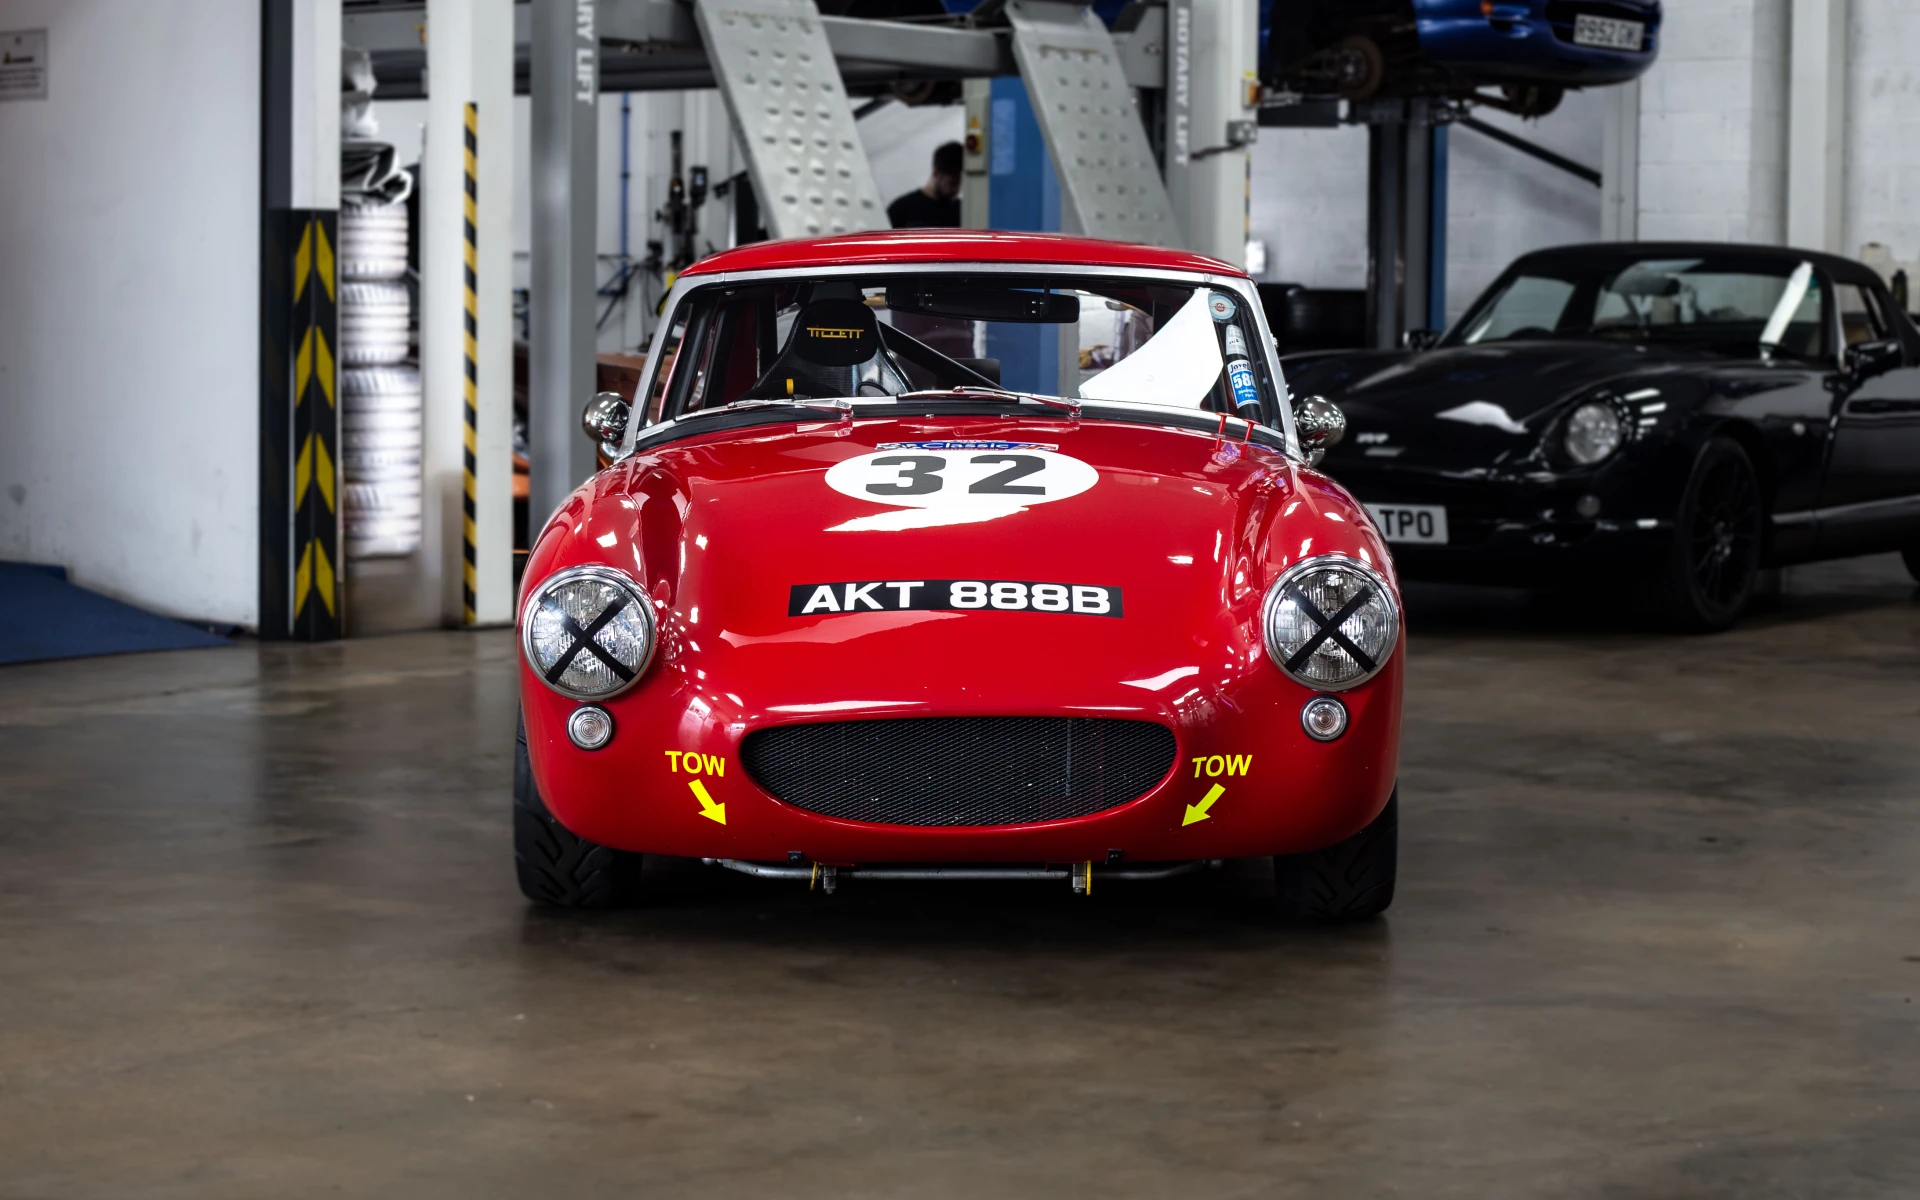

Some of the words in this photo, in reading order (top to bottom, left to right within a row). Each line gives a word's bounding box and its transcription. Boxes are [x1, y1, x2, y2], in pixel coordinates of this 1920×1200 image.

[577, 0, 593, 41] RY
[1176, 7, 1189, 107] ROTARY
[576, 49, 593, 106] LIFT
[1176, 115, 1188, 167] LIFT
[807, 327, 864, 339] TILLETT
[866, 455, 1046, 495] 32
[1379, 509, 1434, 538] TPO
[801, 581, 924, 613] AKT
[949, 581, 1111, 614] 888B
[665, 750, 725, 777] TOW
[1192, 754, 1253, 778] TOW
